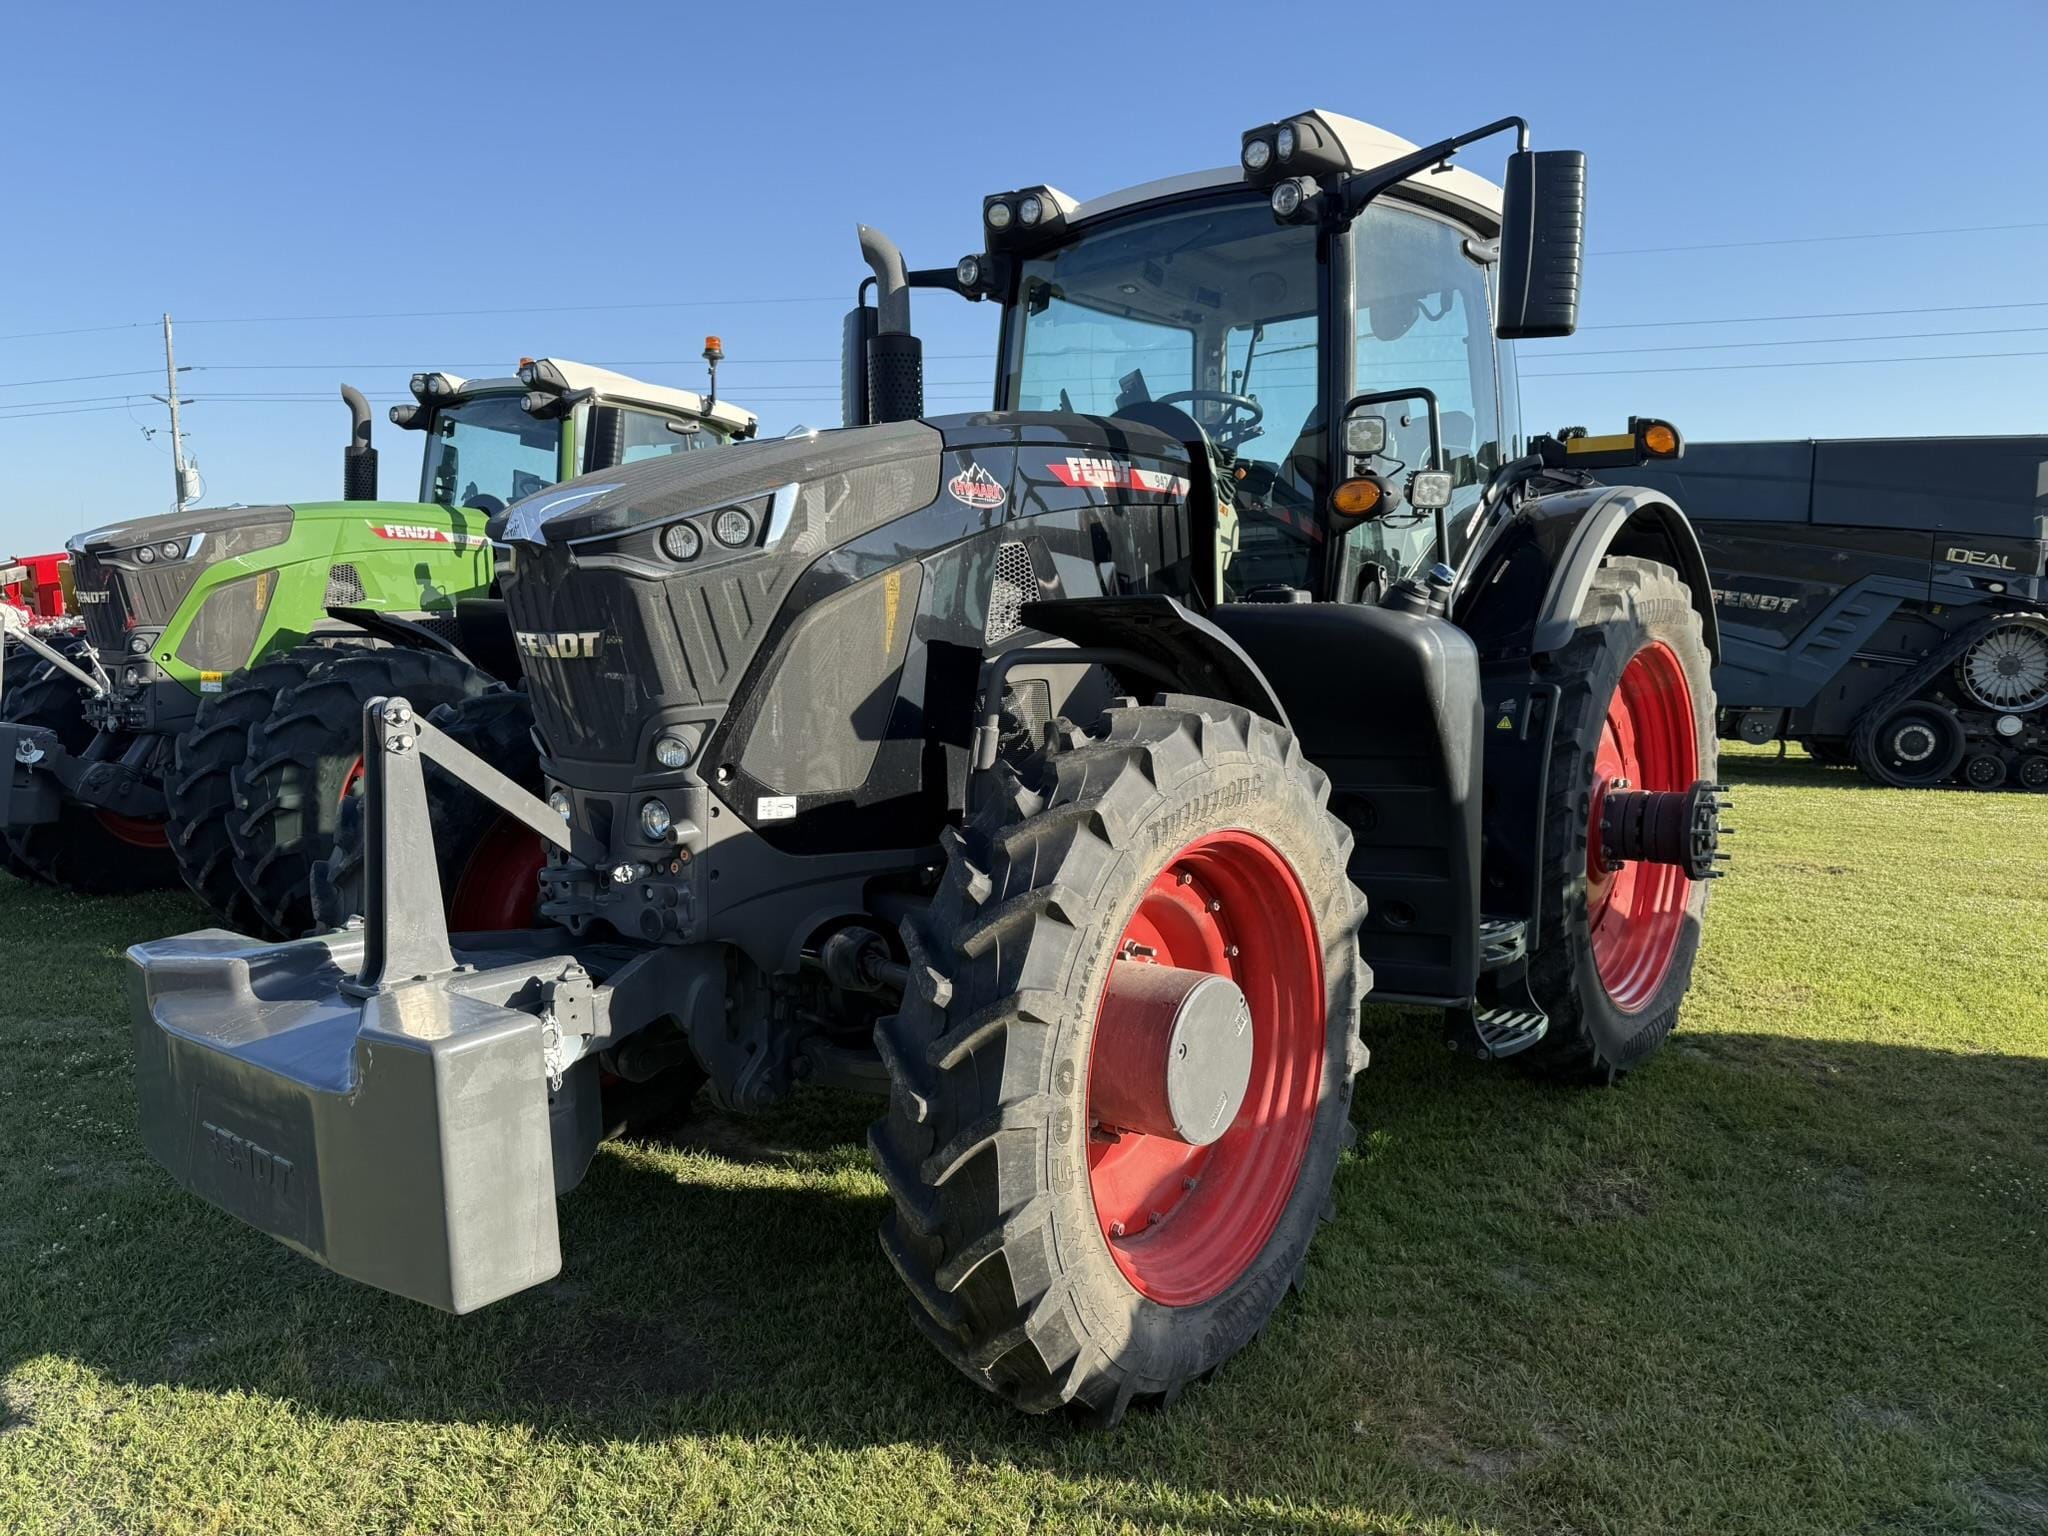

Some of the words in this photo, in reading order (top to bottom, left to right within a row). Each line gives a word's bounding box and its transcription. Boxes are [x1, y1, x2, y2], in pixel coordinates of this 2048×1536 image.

[1066, 457, 1132, 483] FENDT
[384, 524, 438, 540] FENDT
[1946, 547, 2016, 571] IDEAL
[1711, 588, 1799, 614] FENDT
[515, 631, 600, 658] FENDT
